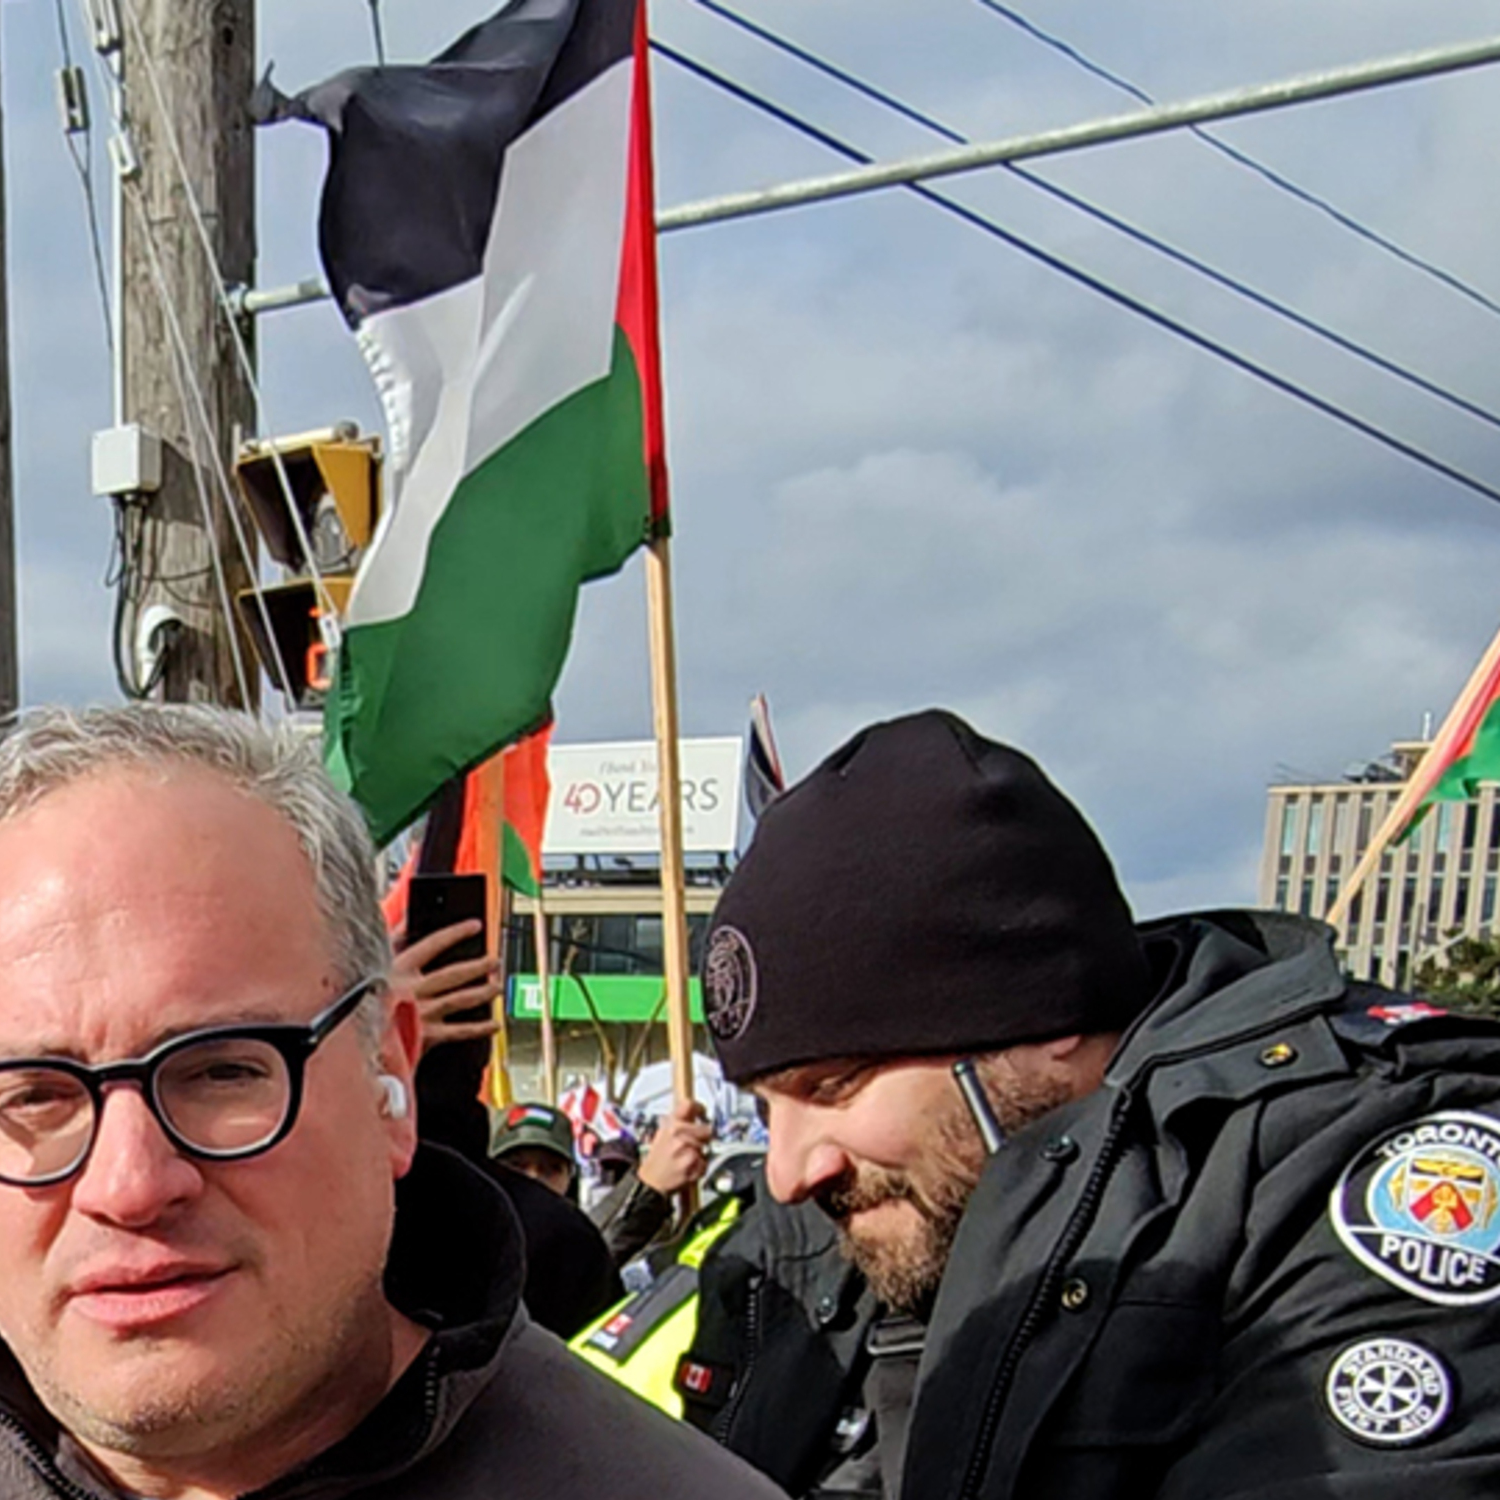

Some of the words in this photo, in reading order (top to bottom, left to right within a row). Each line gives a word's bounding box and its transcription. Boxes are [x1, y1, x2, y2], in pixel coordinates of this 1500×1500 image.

[1374, 1123, 1500, 1170] TORONT
[1380, 1234, 1488, 1287] POLICE
[1341, 1344, 1441, 1397] STANDARD
[1333, 1386, 1388, 1434] FIRST
[1399, 1403, 1434, 1434] AID
